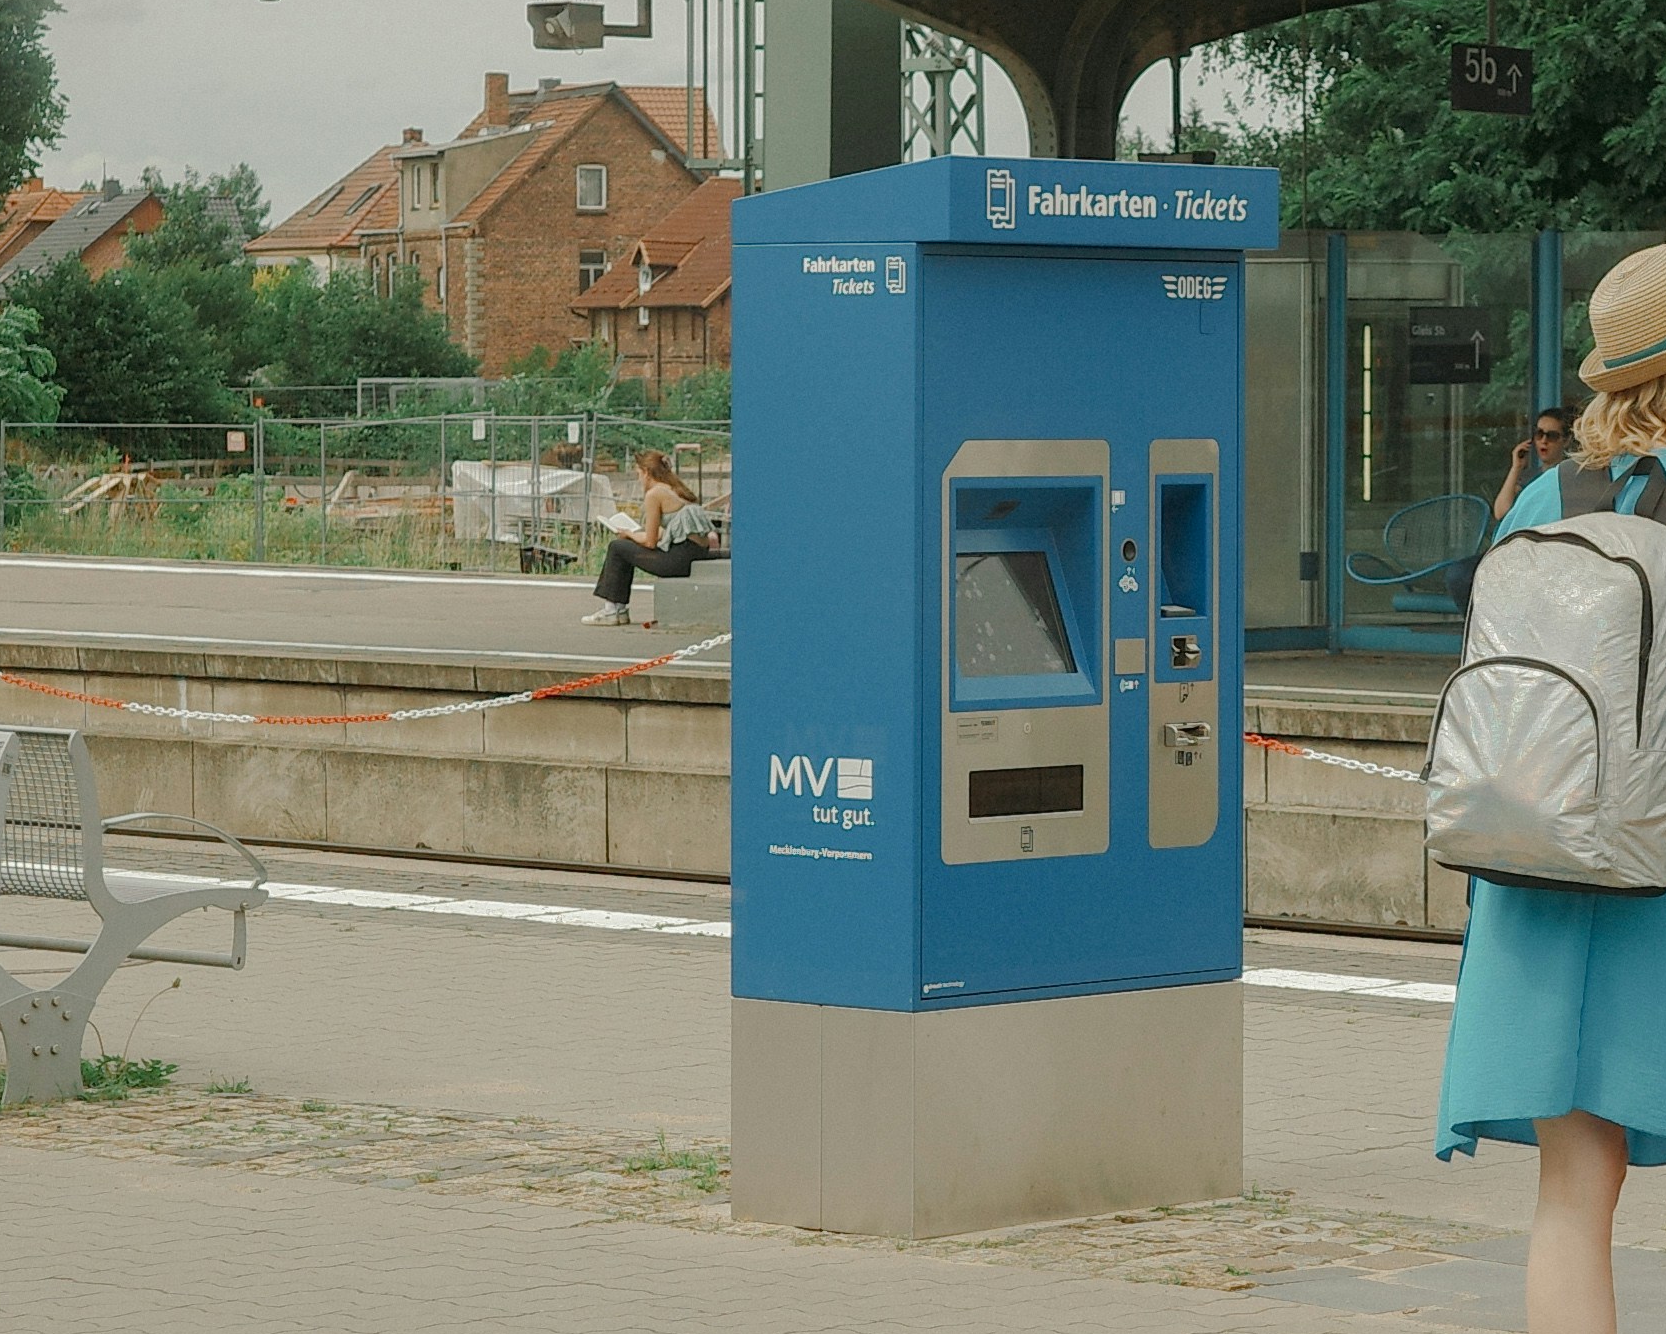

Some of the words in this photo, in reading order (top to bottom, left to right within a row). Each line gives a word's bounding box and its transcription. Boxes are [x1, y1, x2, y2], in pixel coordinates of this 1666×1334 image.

[1465, 47, 1498, 84] 5b
[1028, 183, 1157, 218] Fahrkarten
[1174, 188, 1248, 222] Tickets
[802, 256, 875, 273] Fahrkarten
[832, 278, 875, 295] Tickets
[1177, 276, 1212, 299] ODEG
[769, 754, 834, 797] MV
[813, 804, 838, 824] tut
[842, 807, 874, 830] gut.
